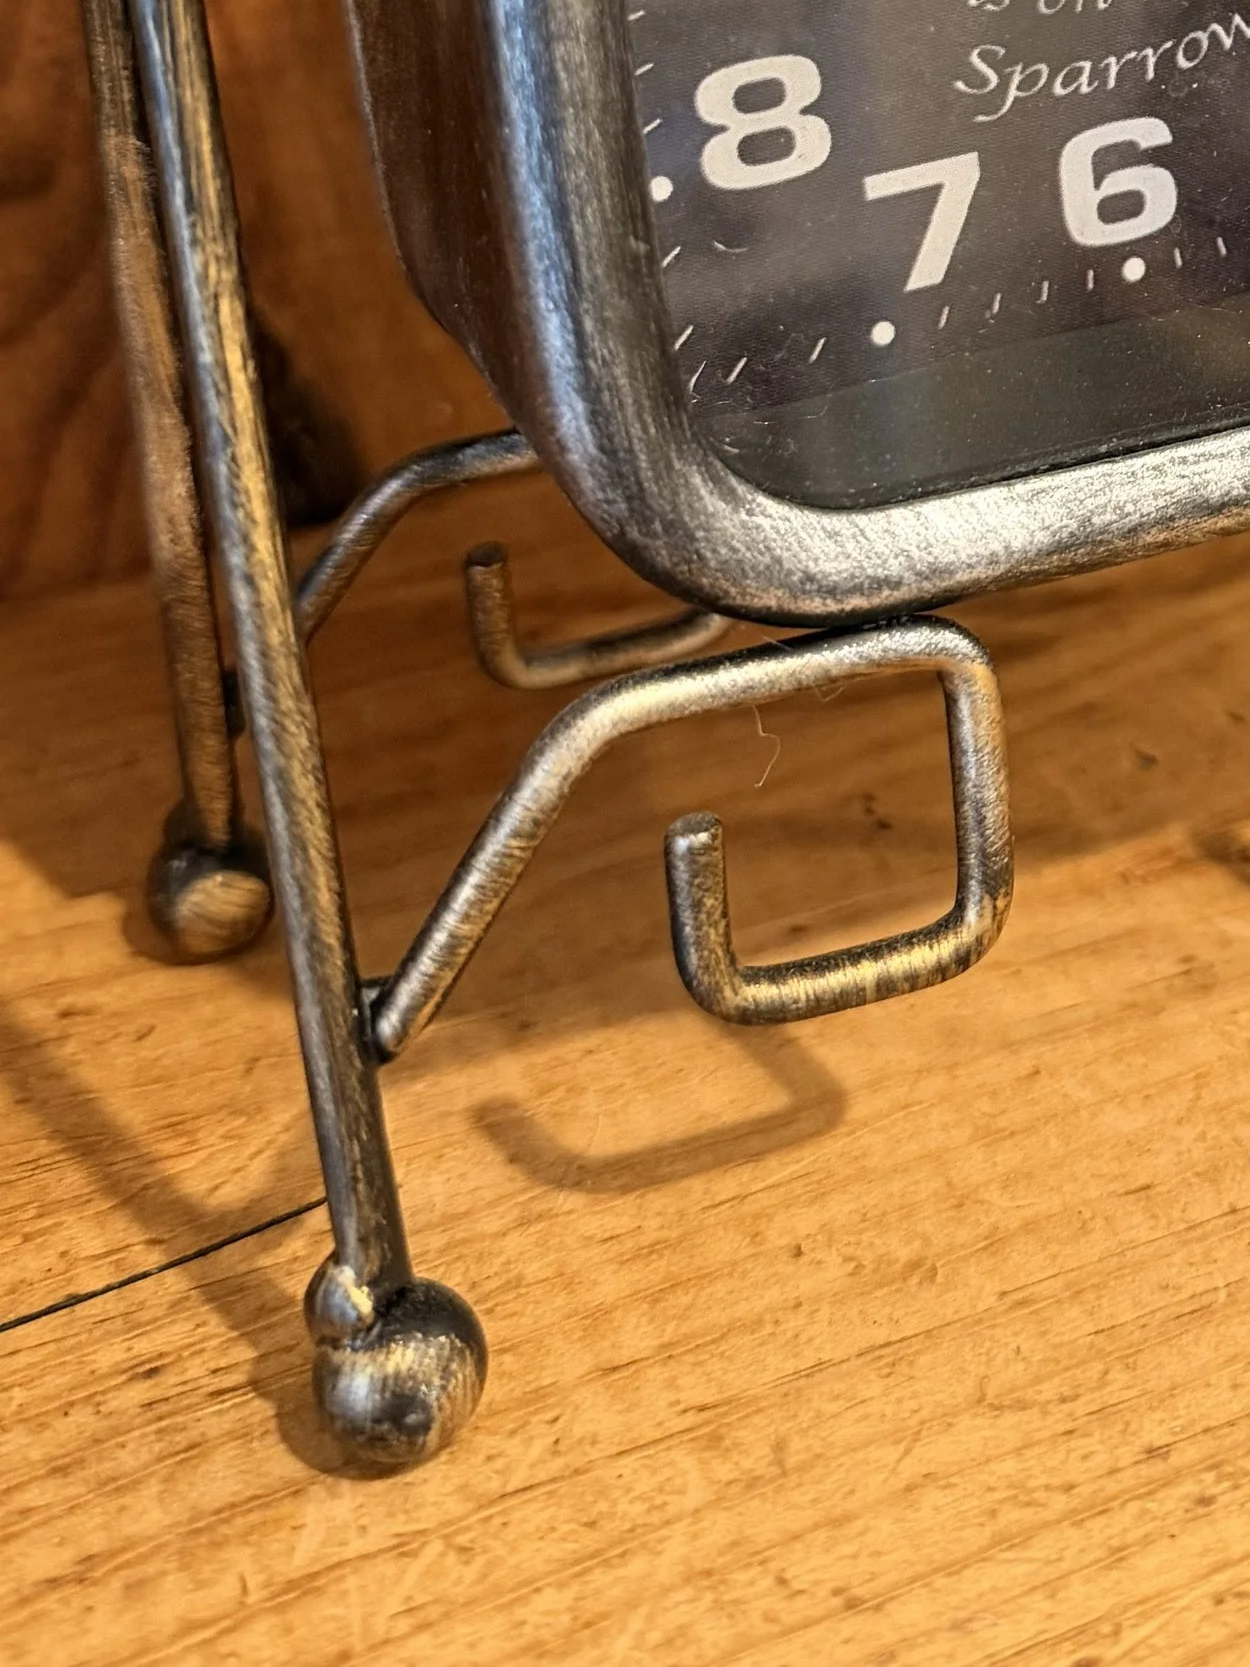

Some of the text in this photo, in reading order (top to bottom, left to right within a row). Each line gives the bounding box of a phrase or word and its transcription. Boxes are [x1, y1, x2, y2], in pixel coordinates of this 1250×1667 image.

[693, 53, 833, 191] 8
[1058, 115, 1179, 248] 6
[862, 151, 980, 293] 7
